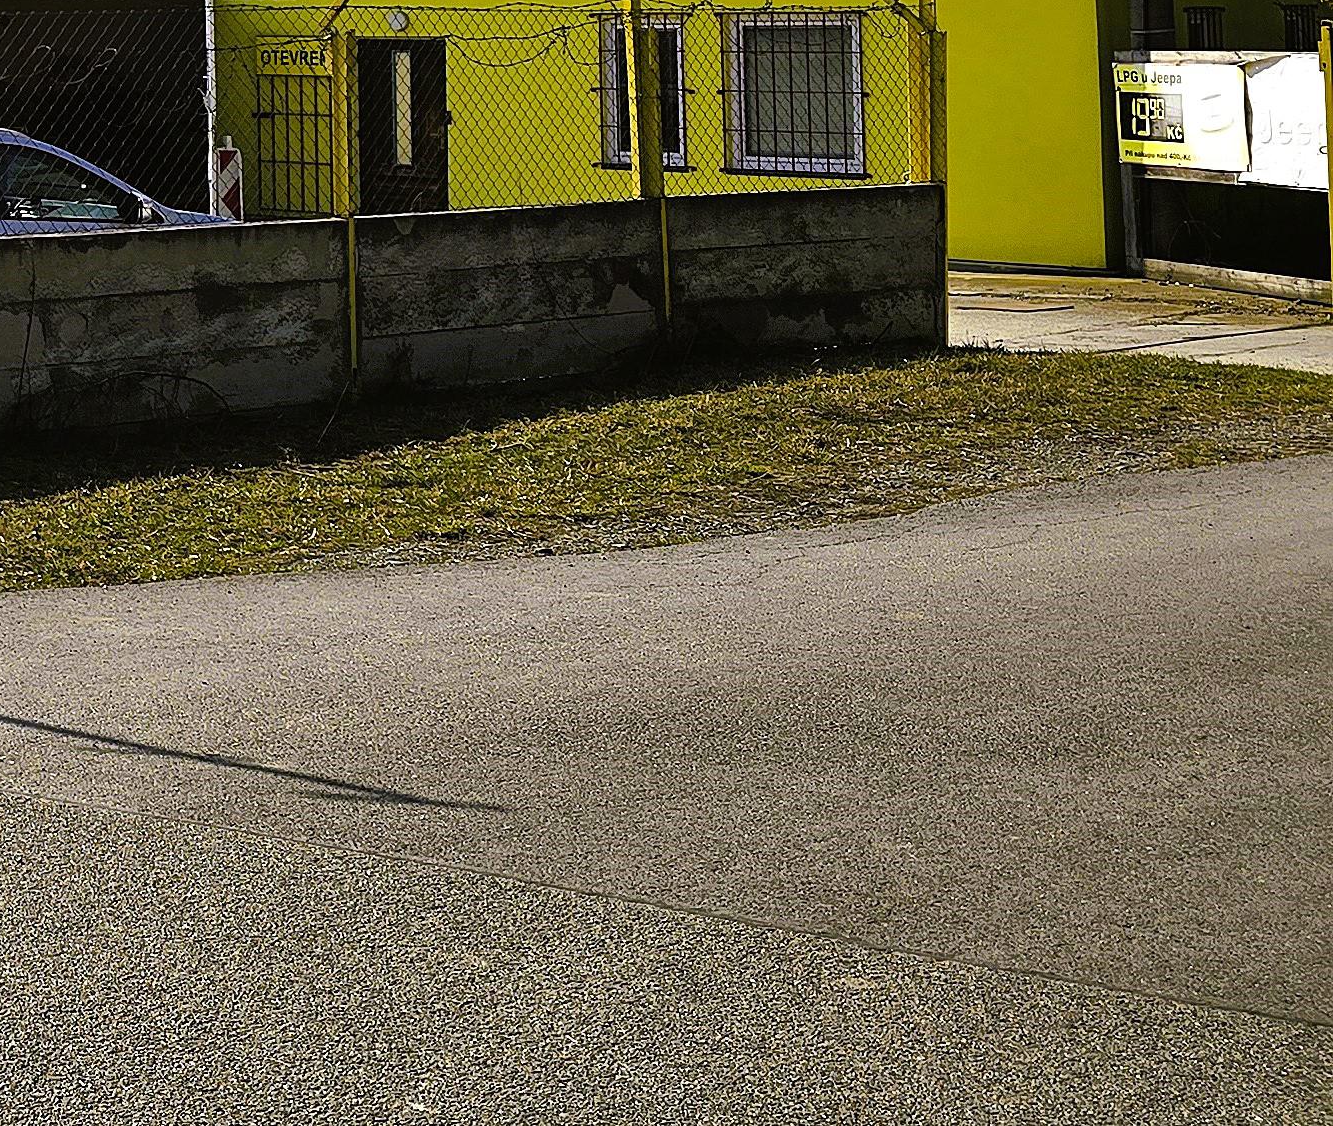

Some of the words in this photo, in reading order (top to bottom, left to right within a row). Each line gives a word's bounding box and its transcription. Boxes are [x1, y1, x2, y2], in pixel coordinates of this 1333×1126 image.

[1116, 70, 1138, 83] LPG
[1141, 74, 1148, 83] u
[1150, 71, 1182, 86] Jeepa
